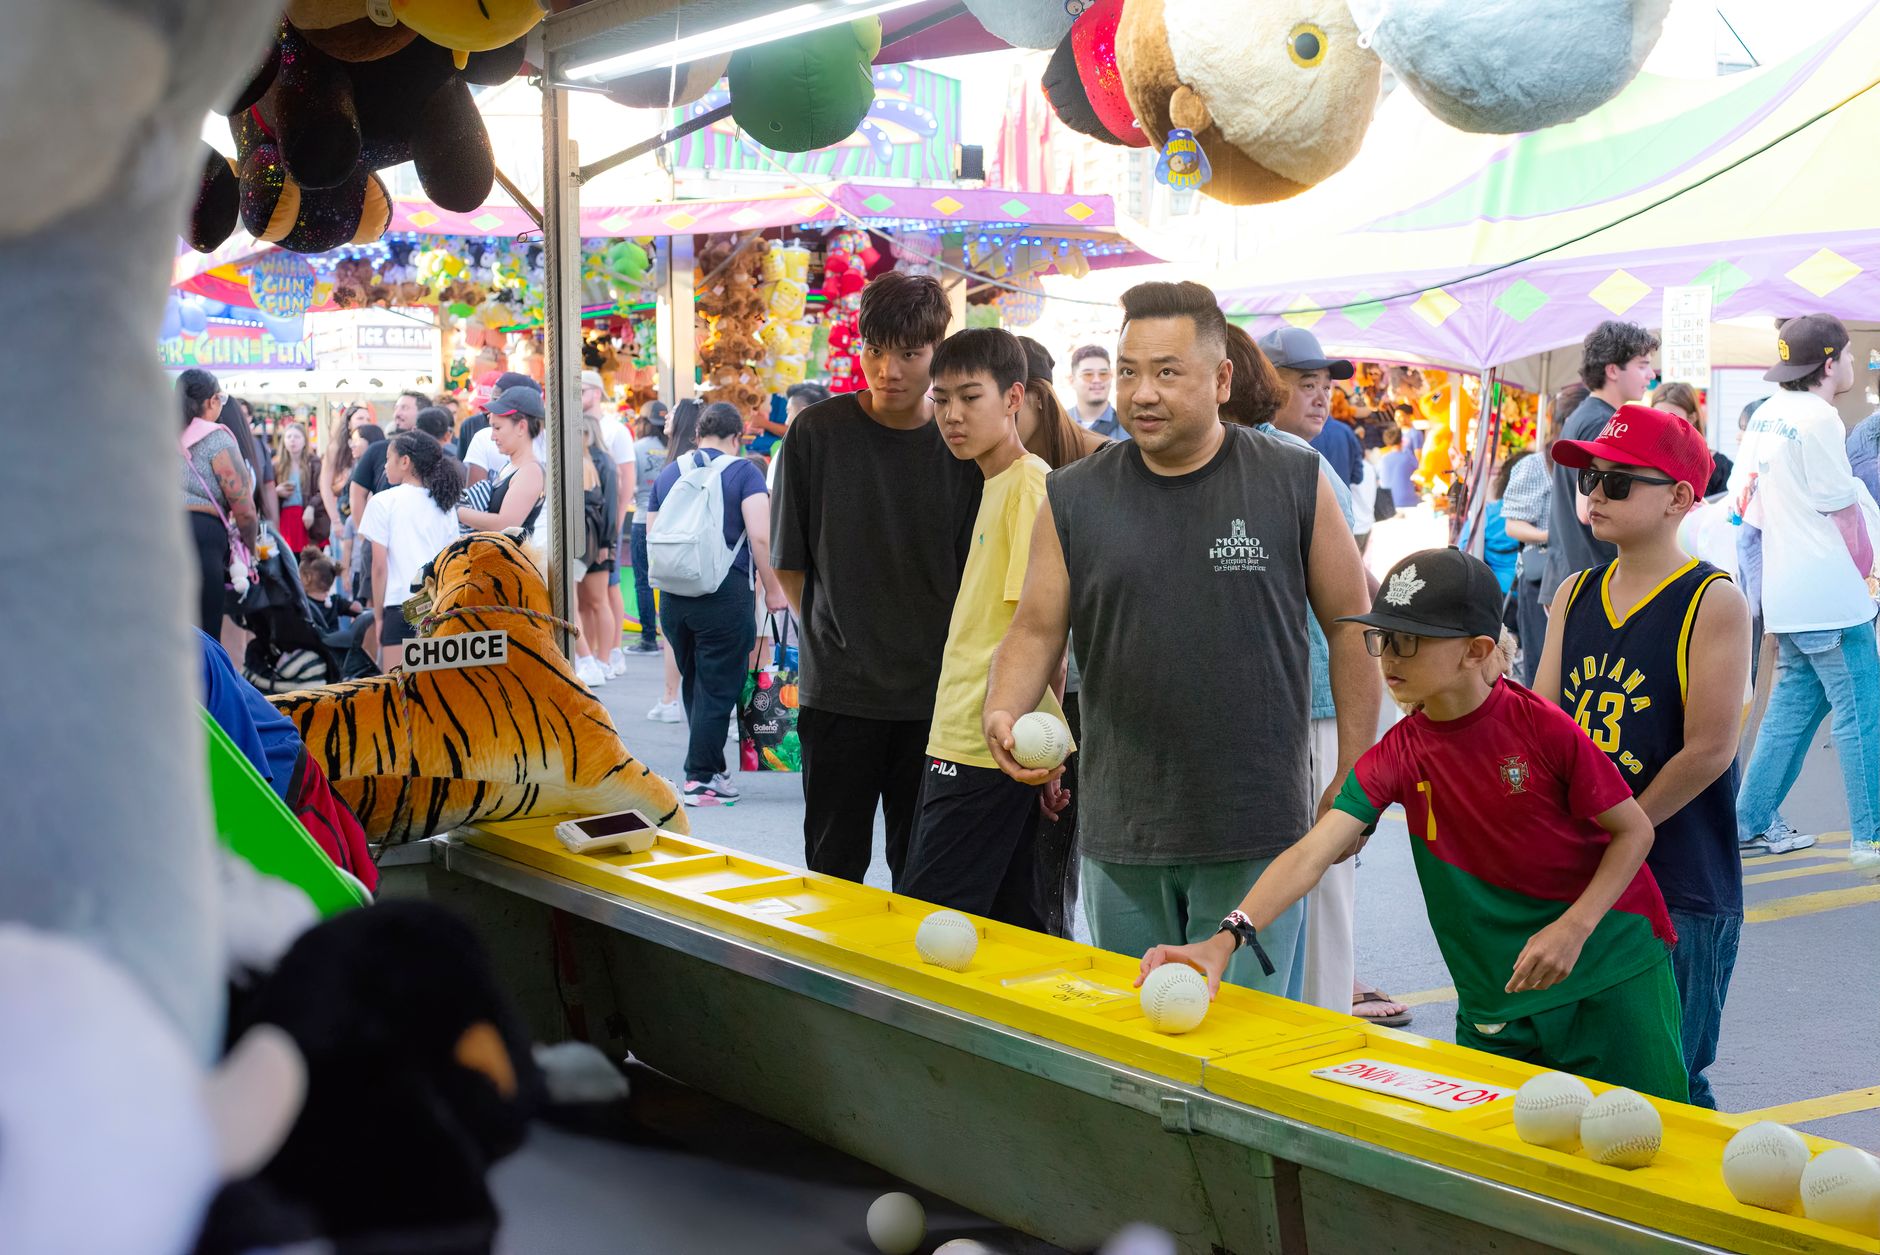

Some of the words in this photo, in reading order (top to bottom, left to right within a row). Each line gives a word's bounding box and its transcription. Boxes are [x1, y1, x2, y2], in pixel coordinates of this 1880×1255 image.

[1167, 169, 1202, 187] OTTER
[262, 274, 305, 294] GUN
[266, 295, 305, 313] FUN
[358, 327, 384, 347] ICE
[194, 331, 250, 365] GUN
[261, 333, 313, 365] FUN
[1215, 537, 1260, 547] MOMO
[1209, 546, 1270, 559] HOTEL
[404, 634, 504, 667] CHOICE
[1564, 653, 1652, 713] INDIANA
[1573, 689, 1625, 753] 43
[930, 759, 958, 777] FILA
[1417, 780, 1437, 841] 7
[1332, 1063, 1464, 1096] LENING
[1452, 1089, 1501, 1105] NO
